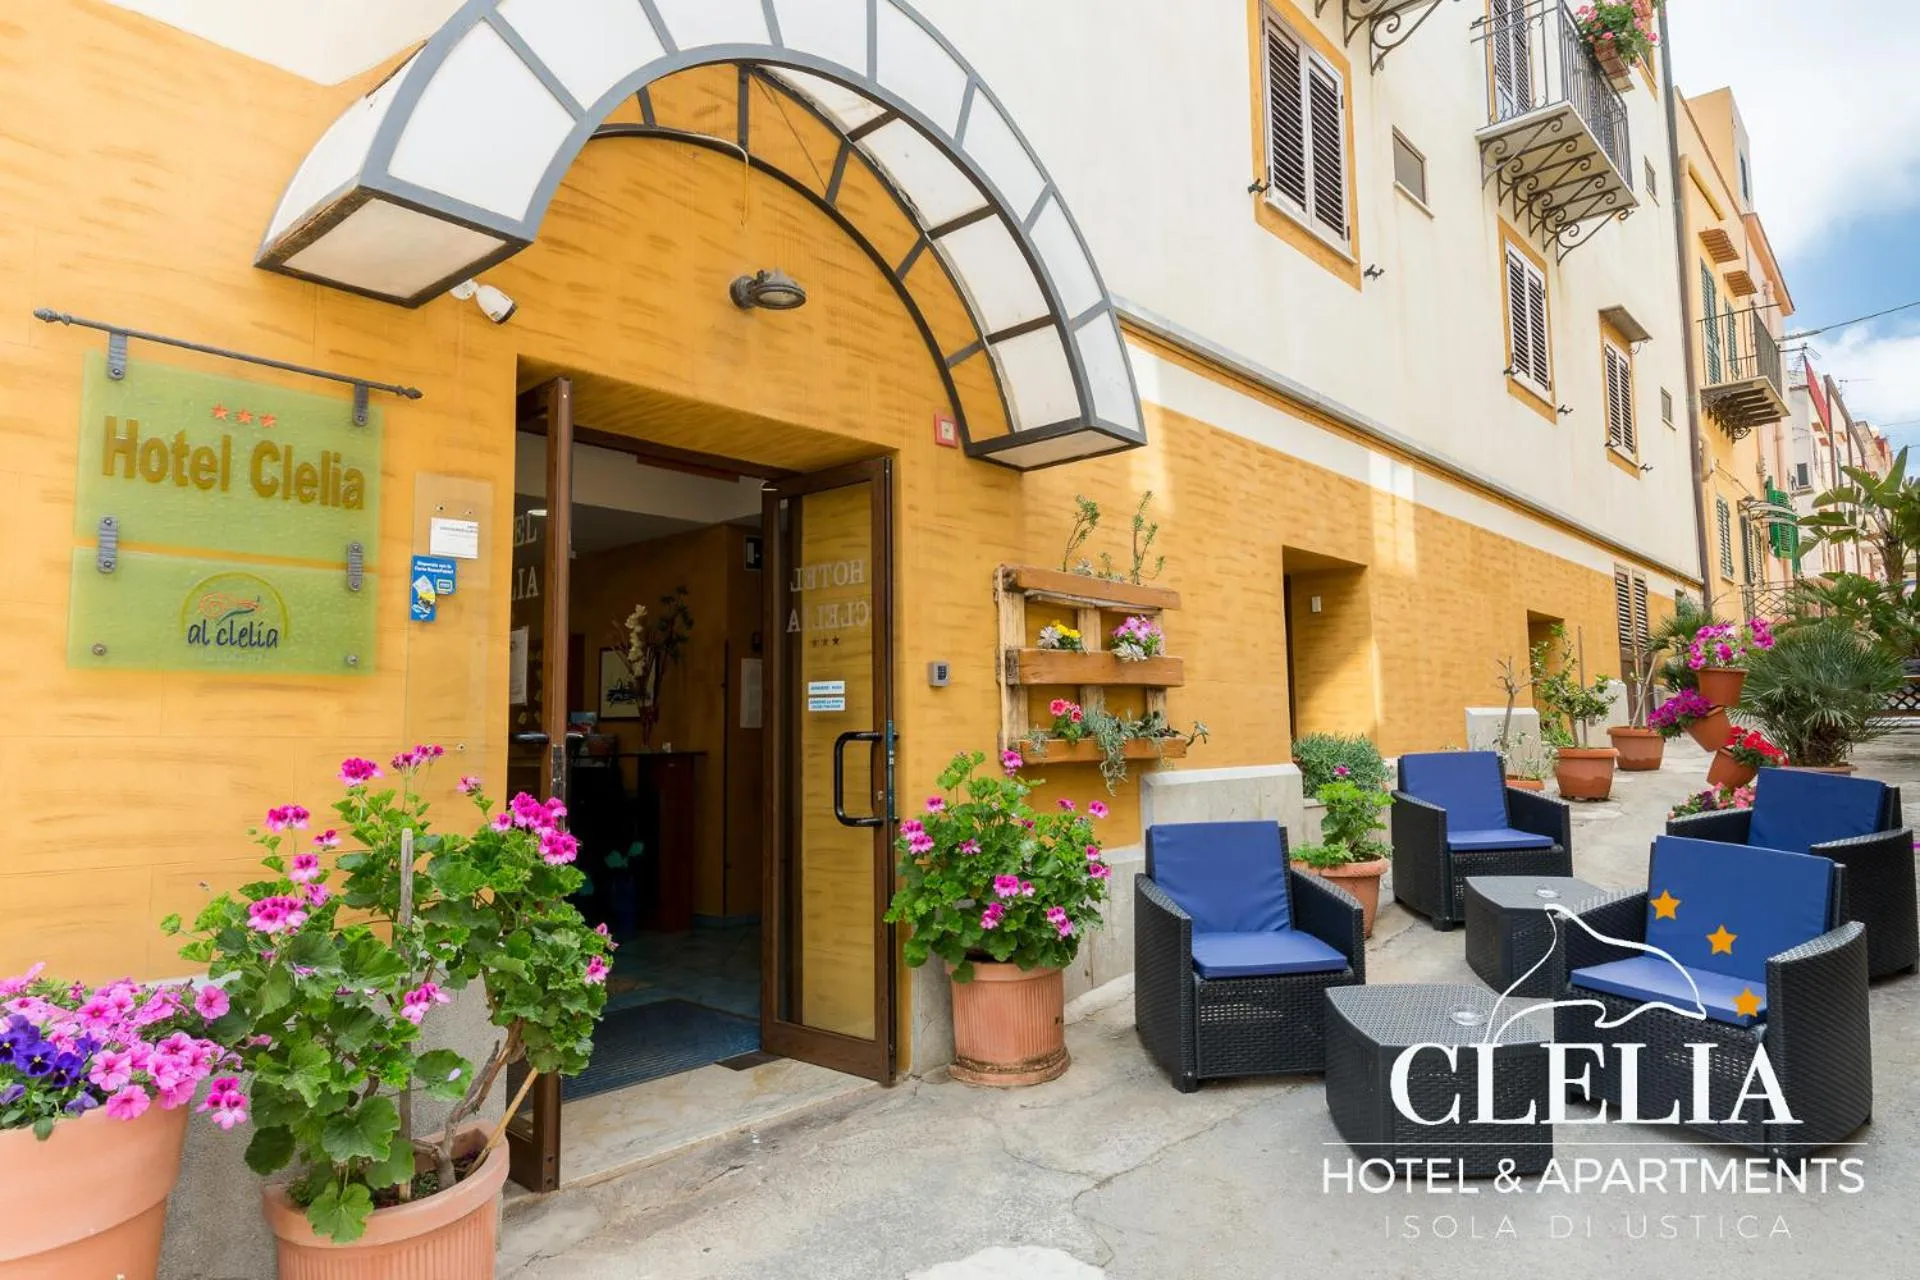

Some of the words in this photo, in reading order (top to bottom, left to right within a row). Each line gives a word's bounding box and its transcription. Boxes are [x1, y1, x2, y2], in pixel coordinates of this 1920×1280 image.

[102, 415, 232, 493] Hotel
[250, 439, 366, 511] Clelia
[187, 617, 210, 646] al
[216, 619, 279, 650] clelia
